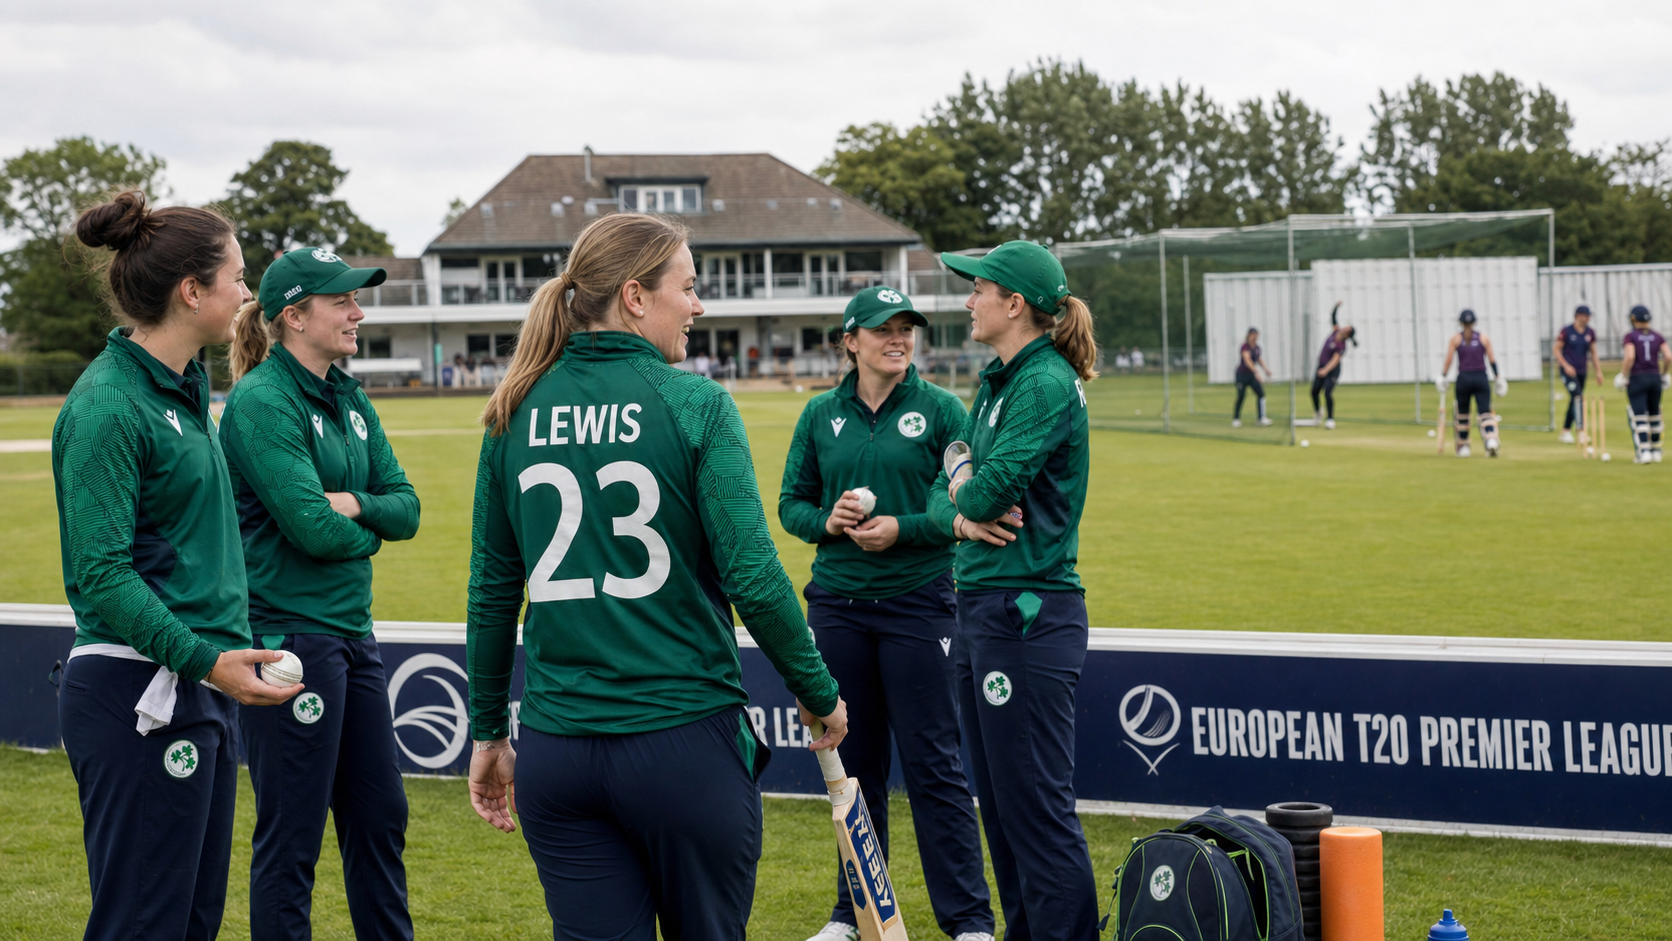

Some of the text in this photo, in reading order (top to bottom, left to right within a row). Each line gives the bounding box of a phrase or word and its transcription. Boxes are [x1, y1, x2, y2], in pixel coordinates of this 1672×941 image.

[528, 403, 643, 447] LEWIS
[518, 460, 672, 603] 23
[1191, 707, 1344, 762] EUROPEAN
[1353, 713, 1410, 766] T20
[1420, 716, 1554, 772] PREMIER
